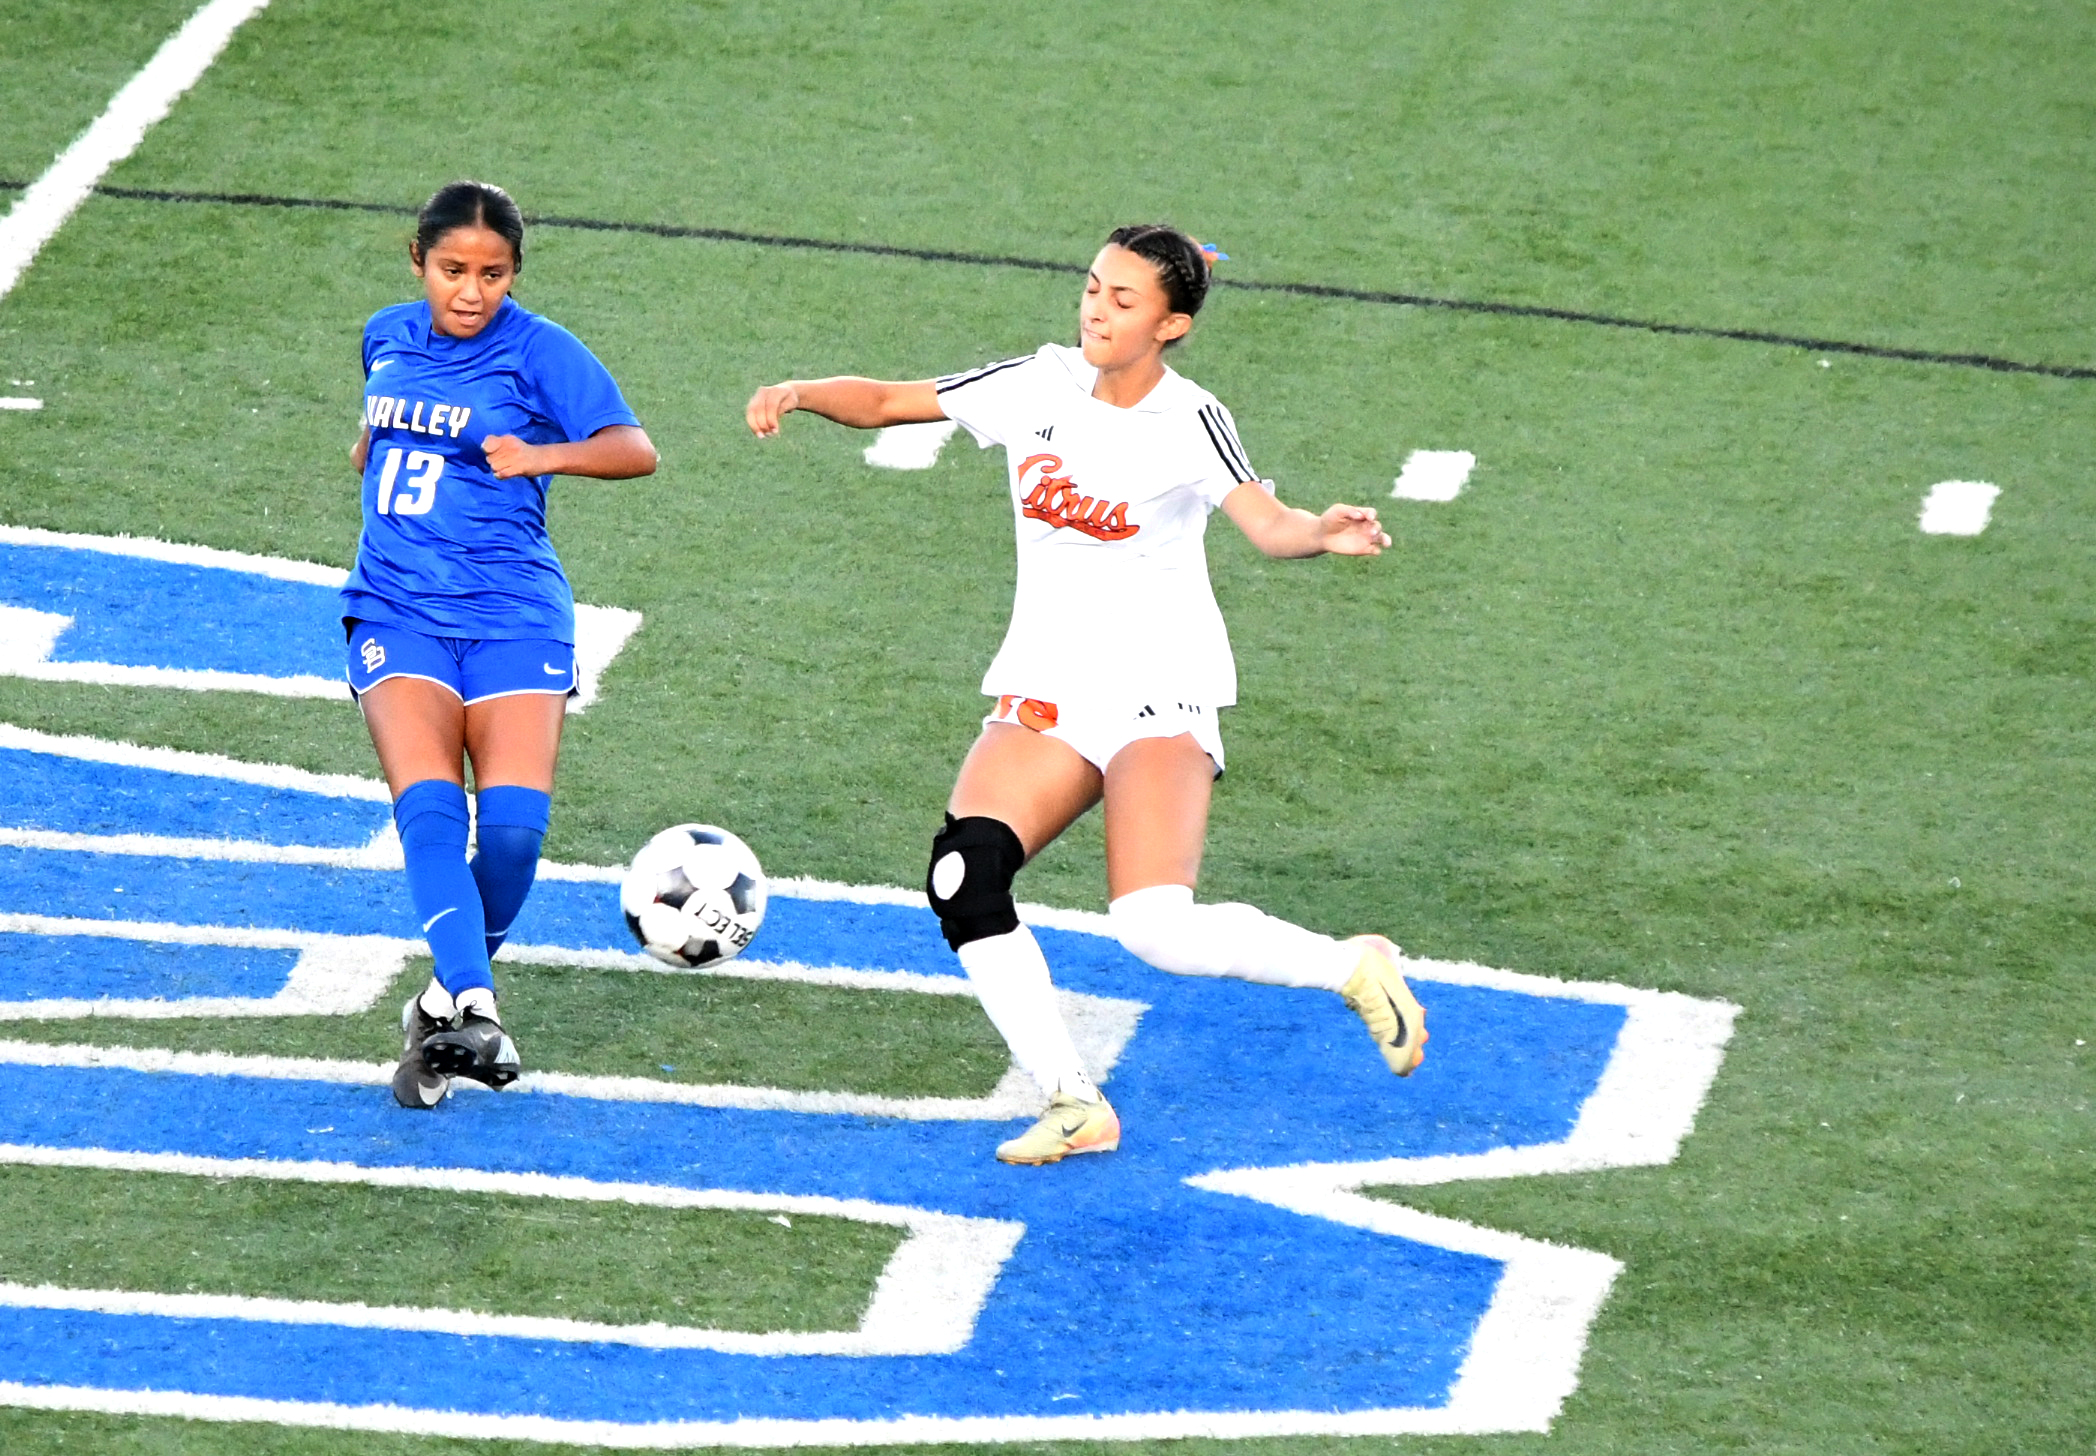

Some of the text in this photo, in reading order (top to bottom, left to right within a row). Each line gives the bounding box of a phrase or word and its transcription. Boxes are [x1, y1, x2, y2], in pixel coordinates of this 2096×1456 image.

[377, 448, 445, 515] 13
[1017, 453, 1140, 541] Citrus
[694, 902, 754, 947] SELECT
